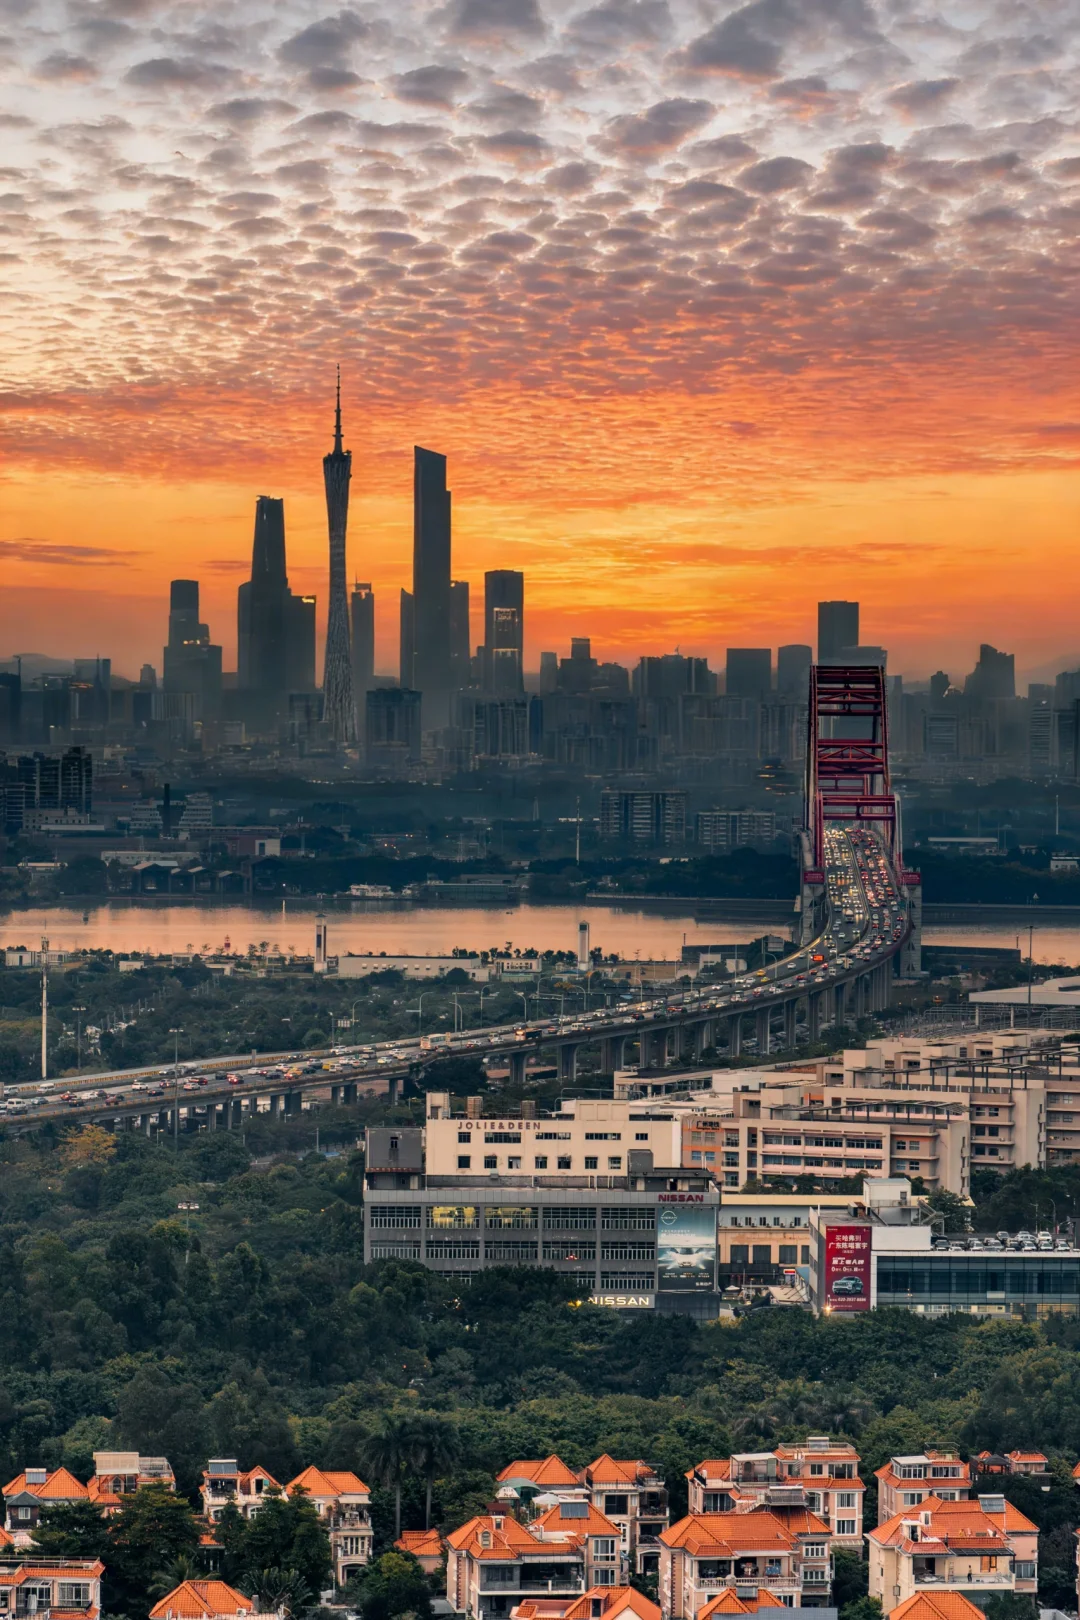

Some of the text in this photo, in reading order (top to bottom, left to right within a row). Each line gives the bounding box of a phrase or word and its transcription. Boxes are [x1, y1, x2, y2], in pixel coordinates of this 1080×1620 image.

[458, 1121, 541, 1130] JOLIE&DEEN
[658, 1194, 704, 1202] NISSAN
[588, 1296, 649, 1305] NISSAN
